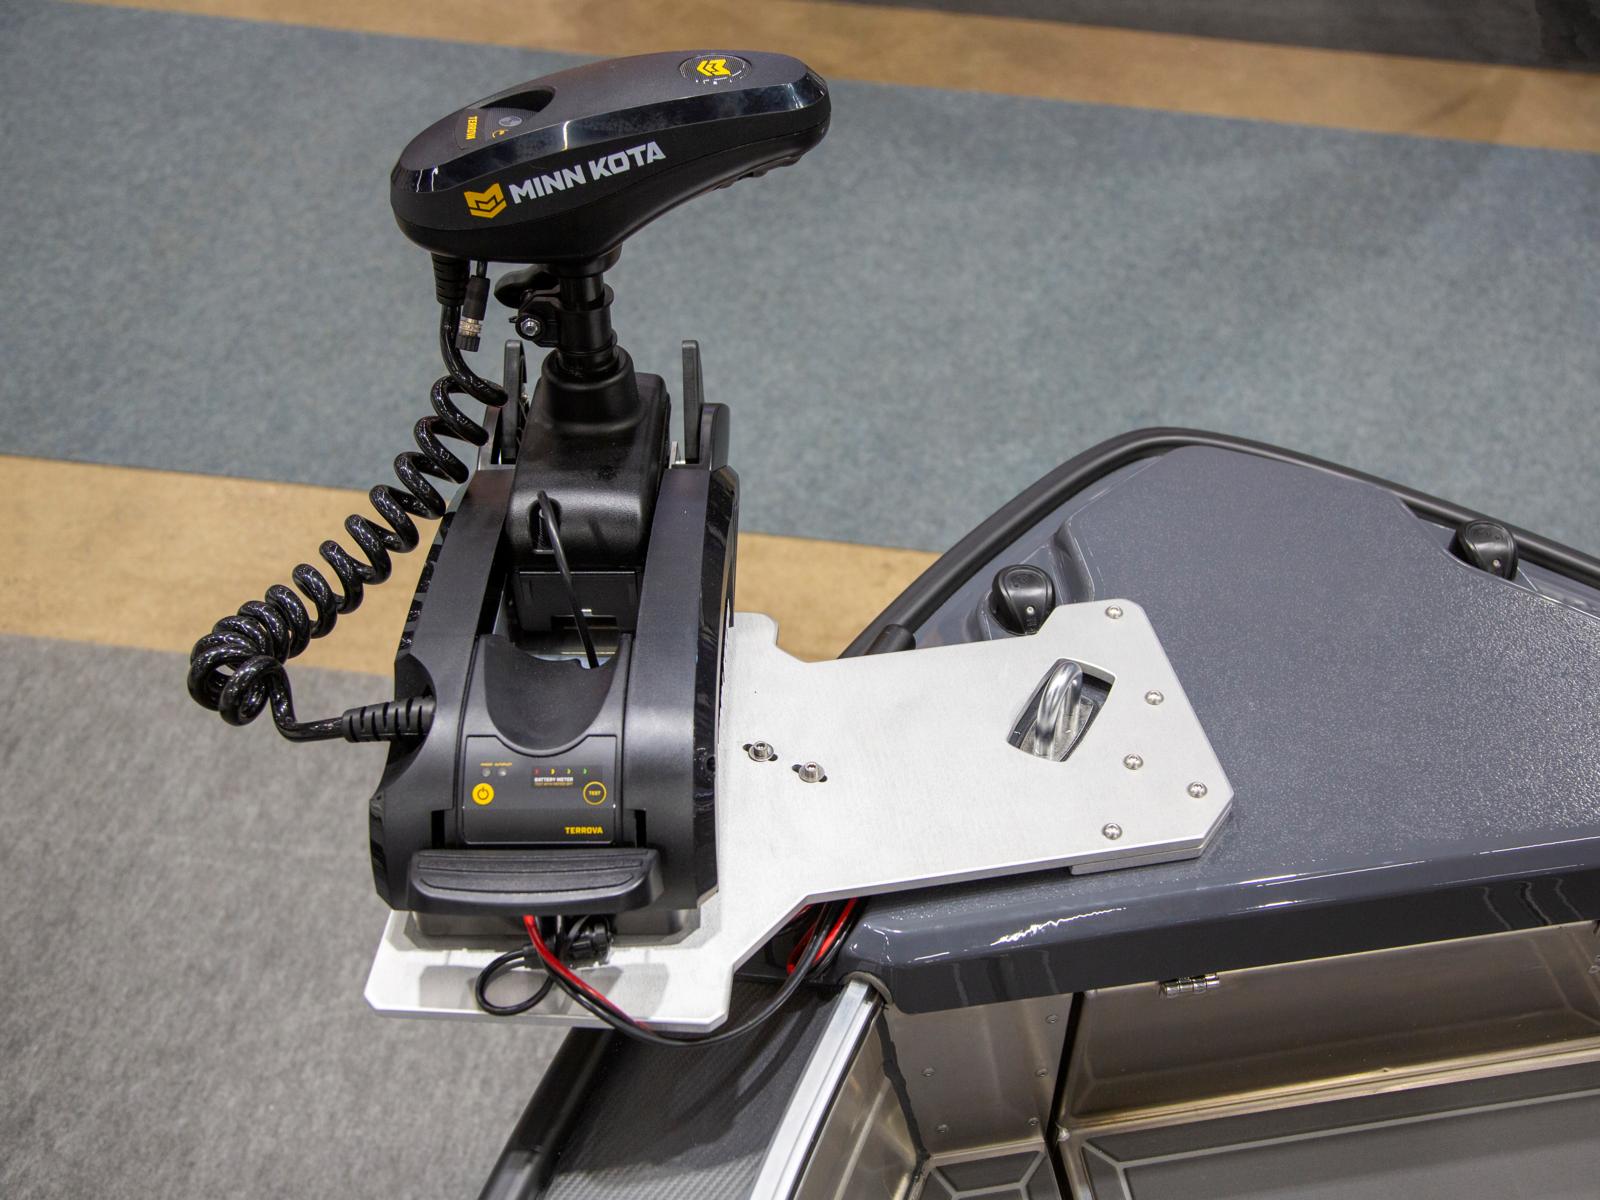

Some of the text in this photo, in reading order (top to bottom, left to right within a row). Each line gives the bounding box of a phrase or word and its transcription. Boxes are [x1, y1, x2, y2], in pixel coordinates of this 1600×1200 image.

[508, 141, 667, 204] MINN KOTA
[565, 826, 604, 834] TERROVA
